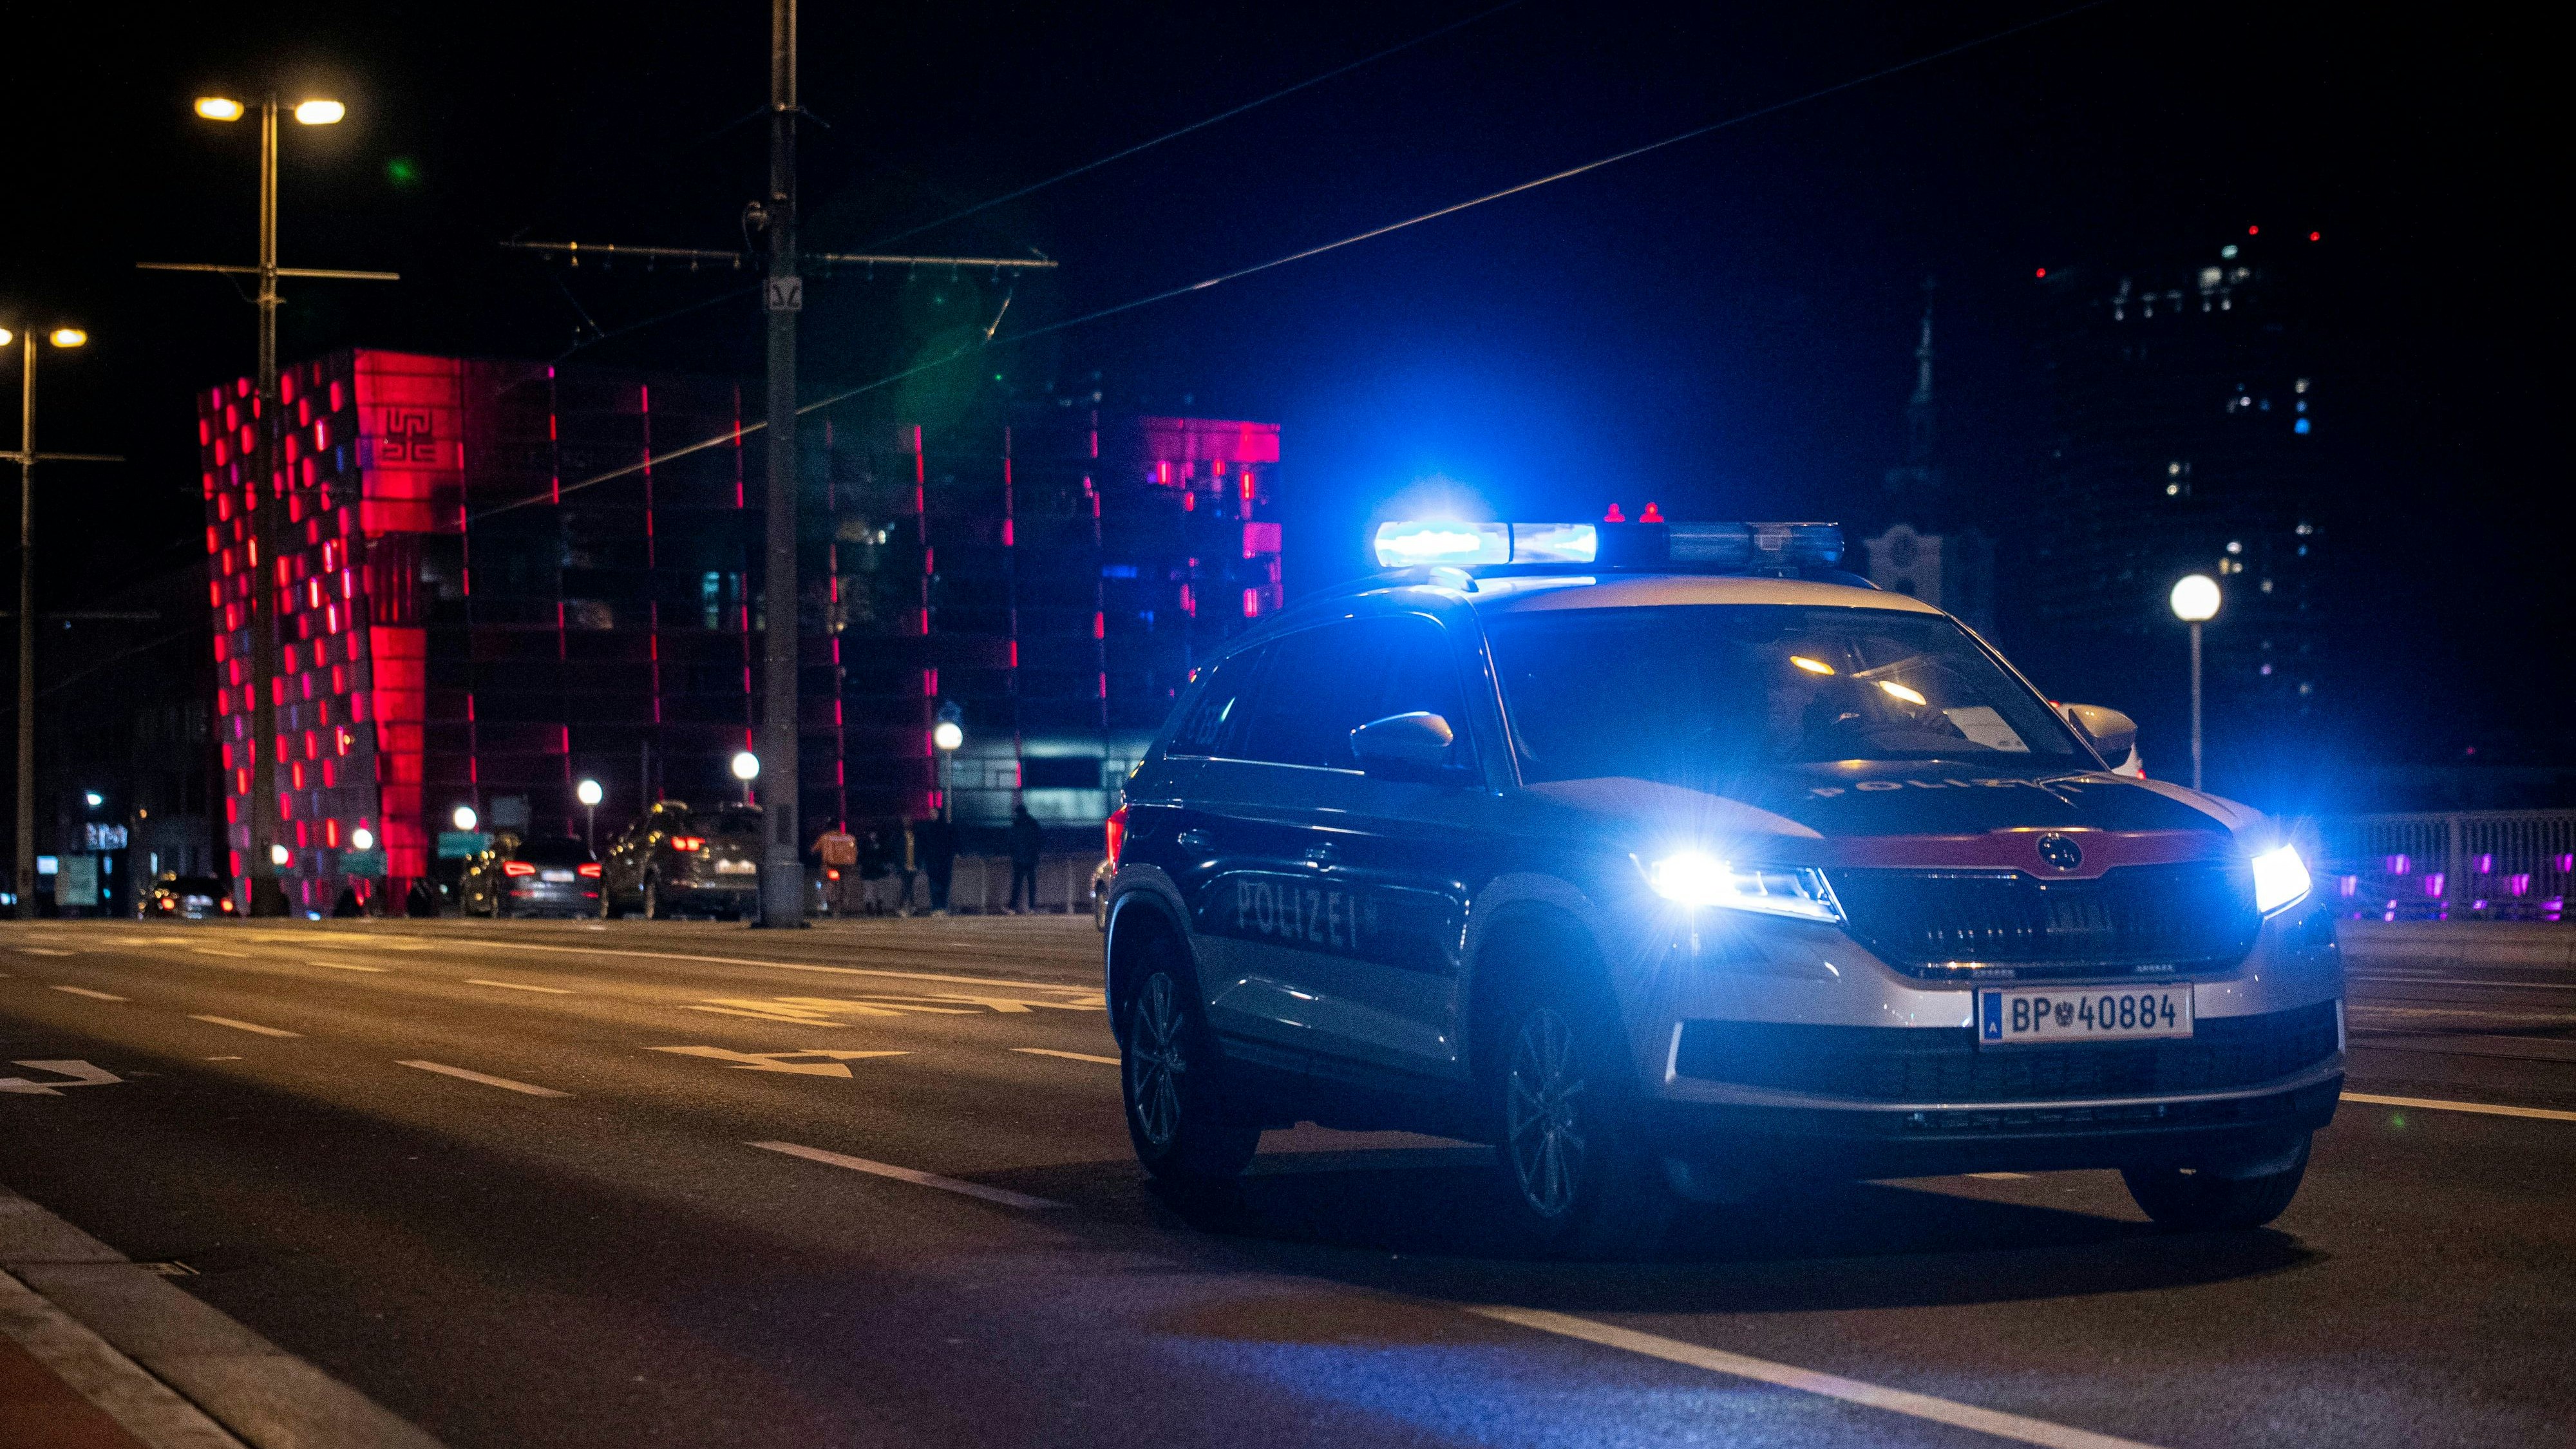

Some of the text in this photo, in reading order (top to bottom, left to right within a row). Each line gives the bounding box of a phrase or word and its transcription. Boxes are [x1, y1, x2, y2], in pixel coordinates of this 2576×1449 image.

[1236, 878, 1358, 949] POLIZEI
[1988, 1021, 1998, 1034] A
[2012, 994, 2176, 1032] BP 40884
